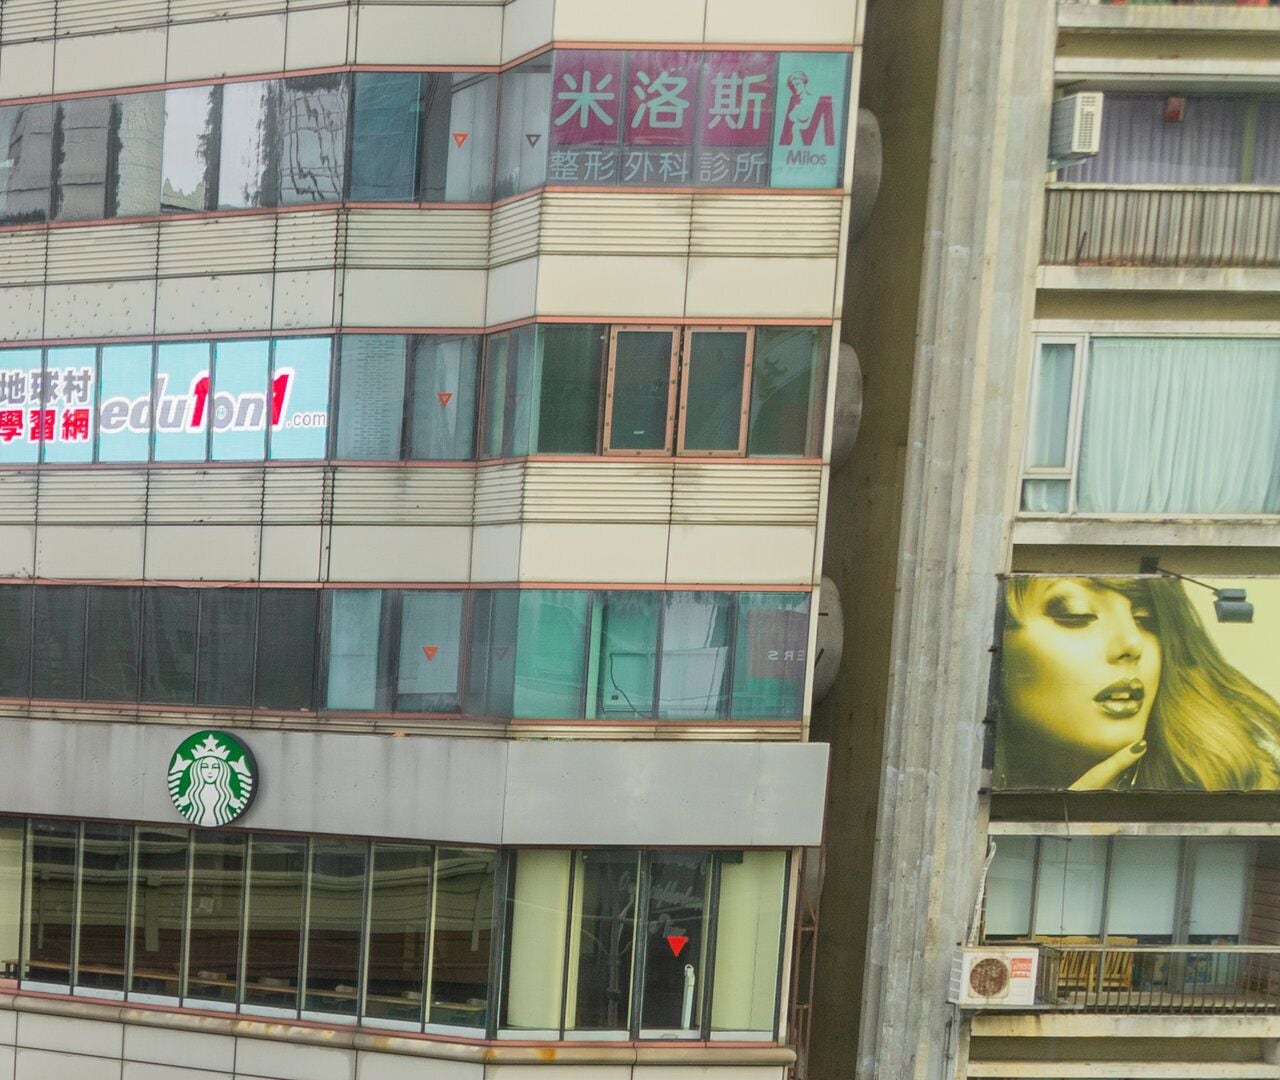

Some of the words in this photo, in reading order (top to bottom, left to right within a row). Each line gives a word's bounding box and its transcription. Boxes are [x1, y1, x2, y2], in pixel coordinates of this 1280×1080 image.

[554, 70, 768, 130] 米洛斯
[548, 150, 767, 183] 整形外科診所
[785, 151, 828, 168] Milos
